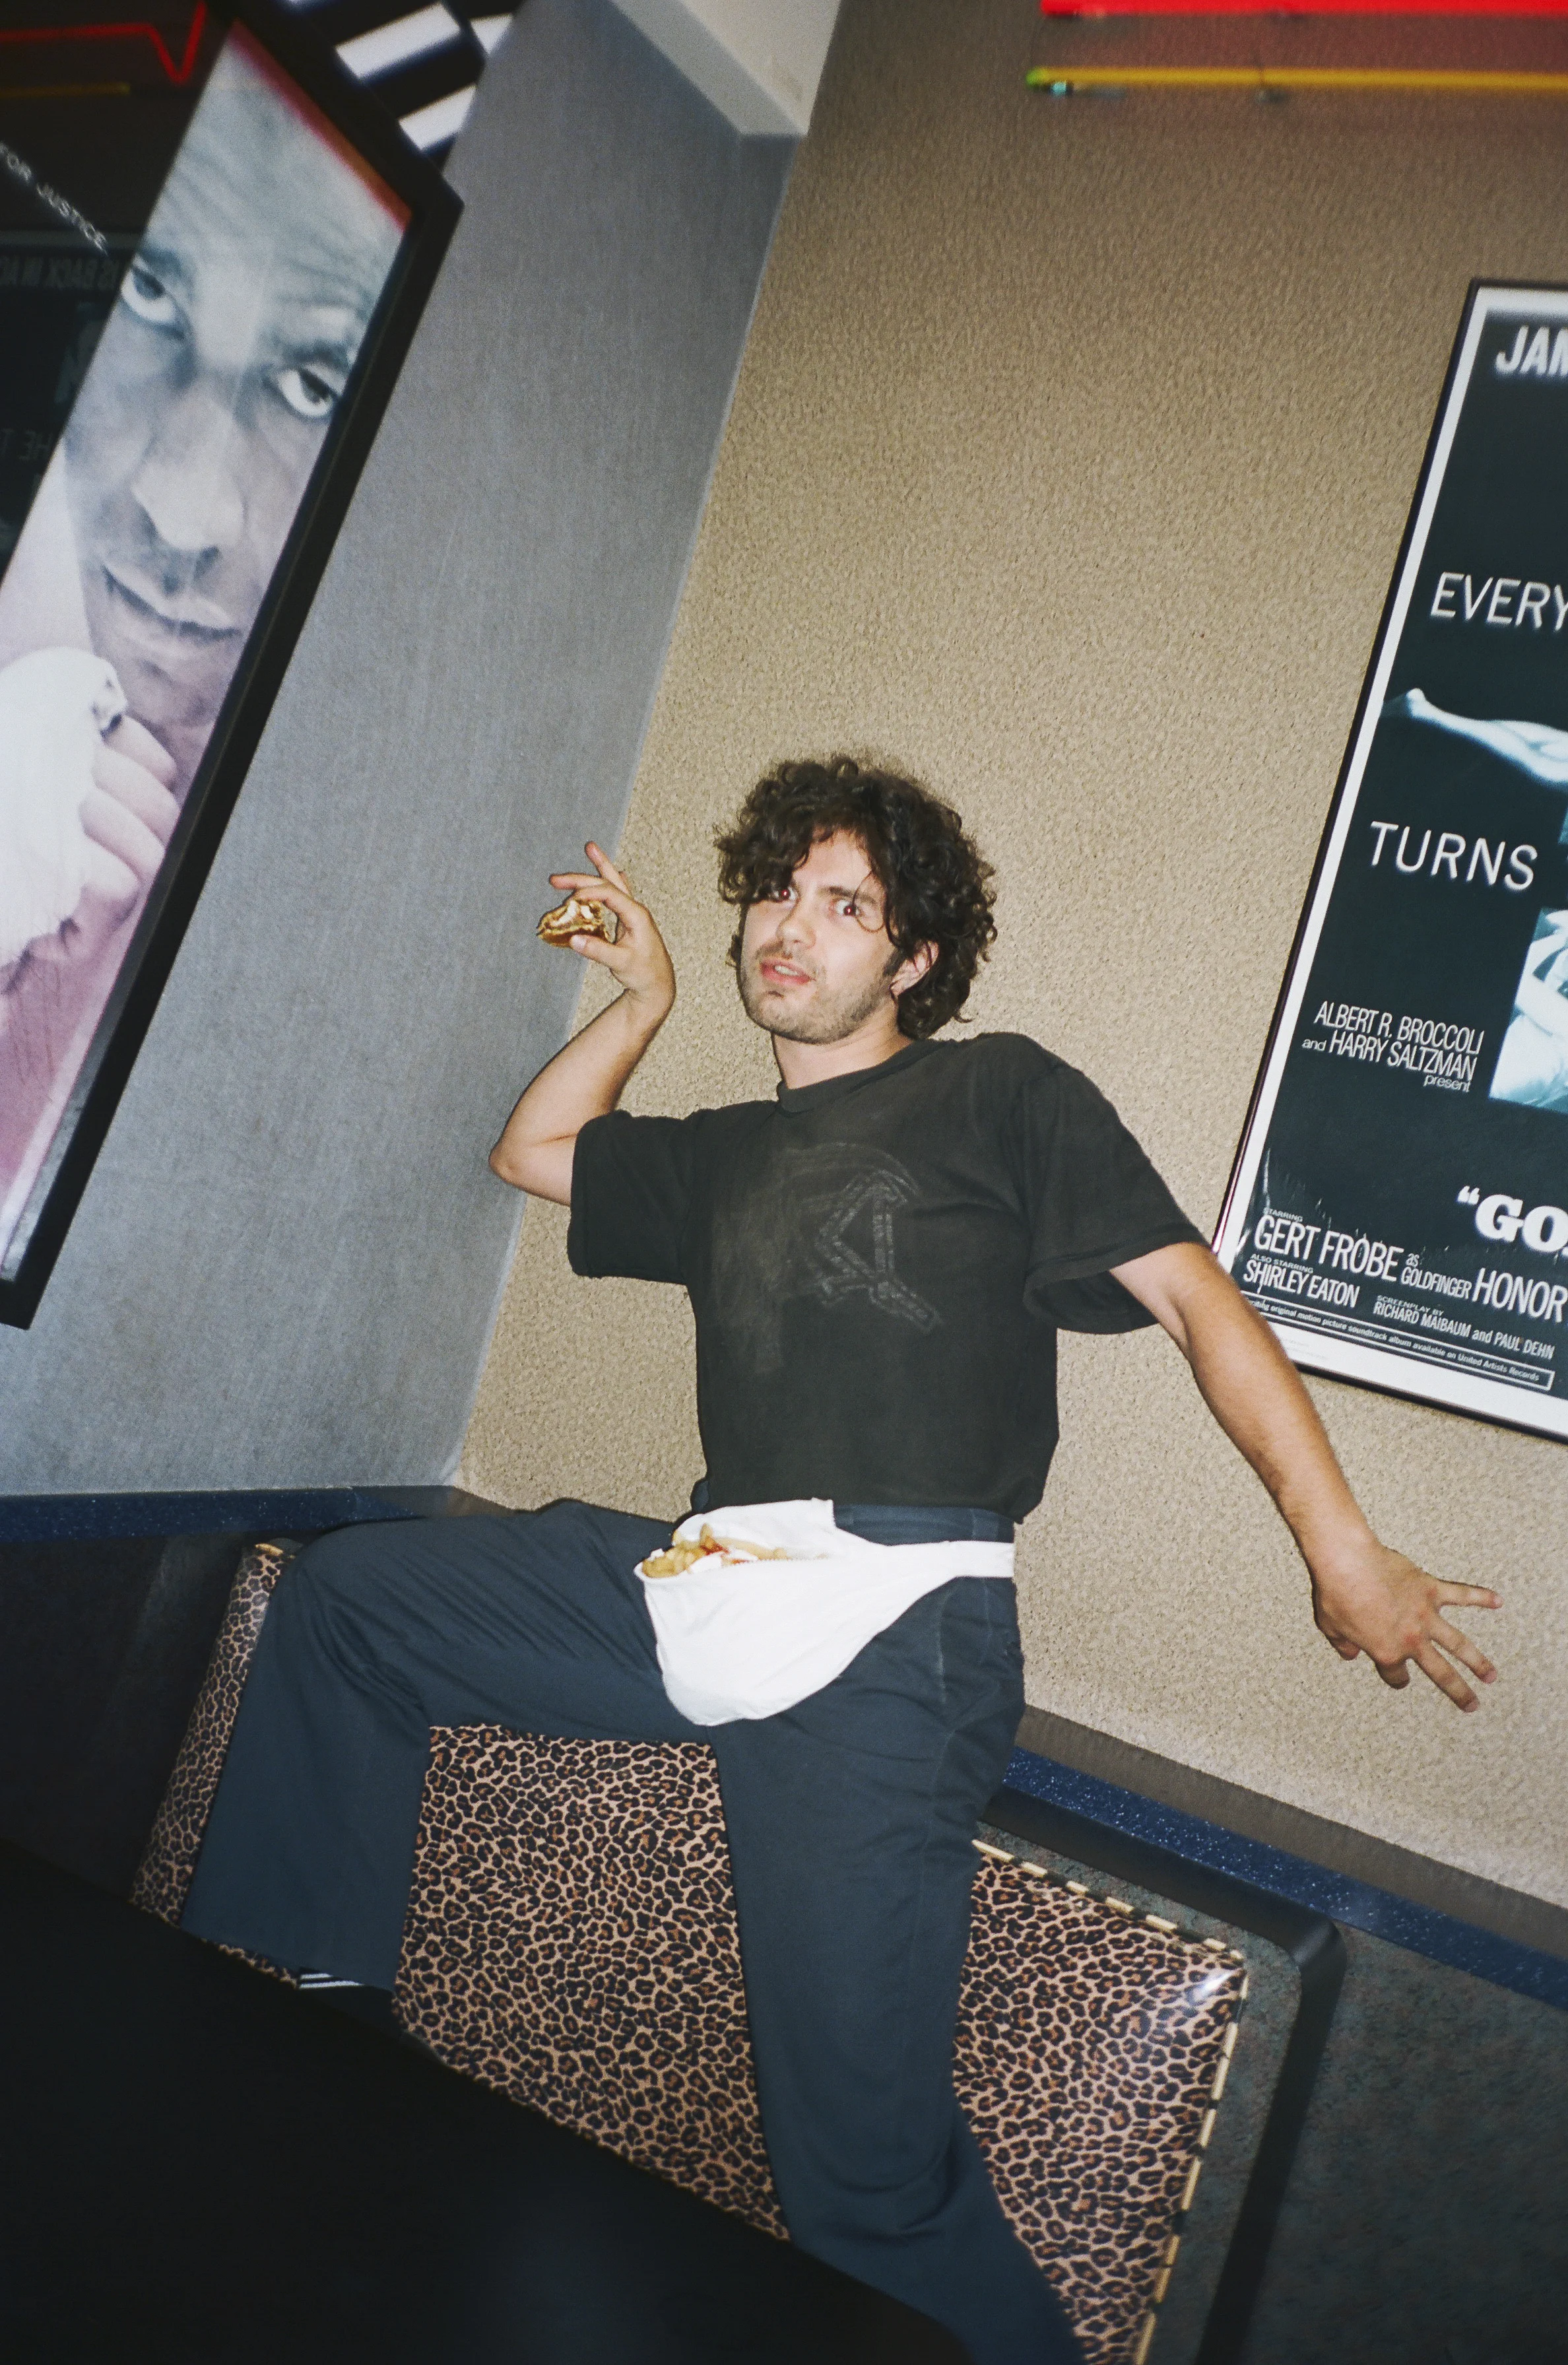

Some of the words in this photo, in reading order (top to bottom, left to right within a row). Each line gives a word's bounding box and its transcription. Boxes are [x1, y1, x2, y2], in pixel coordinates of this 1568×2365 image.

[36, 183, 108, 255] JUSTICE
[1430, 571, 1568, 631] EVERY
[1369, 821, 1538, 891] TURNS
[1313, 1001, 1379, 1034] ALBERT
[1377, 1013, 1393, 1038] R.
[1397, 1016, 1484, 1055] BROCCOLI
[1302, 1038, 1326, 1051] and
[1328, 1030, 1388, 1062] HARRY
[1387, 1041, 1478, 1081] SALTZMAN
[1423, 1075, 1471, 1092] present
[1263, 1207, 1303, 1222] STARRING
[1249, 1253, 1272, 1263] ALSO
[1274, 1260, 1315, 1274] STARRING
[1255, 1215, 1321, 1260] GERT
[1406, 1253, 1420, 1268] as
[1243, 1259, 1310, 1294] SHIRLEY
[1307, 1275, 1360, 1308] EATON
[1377, 1294, 1431, 1313] SCREENPLAY
[1400, 1267, 1472, 1300] GOLDFINGER
[1472, 1267, 1568, 1323] HONOR
[1270, 1306, 1297, 1317] original
[1297, 1312, 1321, 1323] motion
[1322, 1318, 1346, 1330] picture
[1348, 1324, 1387, 1341] soundtrack
[1388, 1335, 1412, 1348] album
[1413, 1341, 1446, 1356] available
[1447, 1350, 1456, 1359] on
[1458, 1353, 1483, 1366] United
[1483, 1360, 1507, 1372] Artists
[1509, 1366, 1540, 1381] Records
[1373, 1301, 1420, 1324] RICHARD
[1420, 1313, 1472, 1338] MAIBAUM
[1472, 1329, 1493, 1343] and
[1493, 1331, 1520, 1351] PAUL
[1522, 1339, 1555, 1360] DEHN
